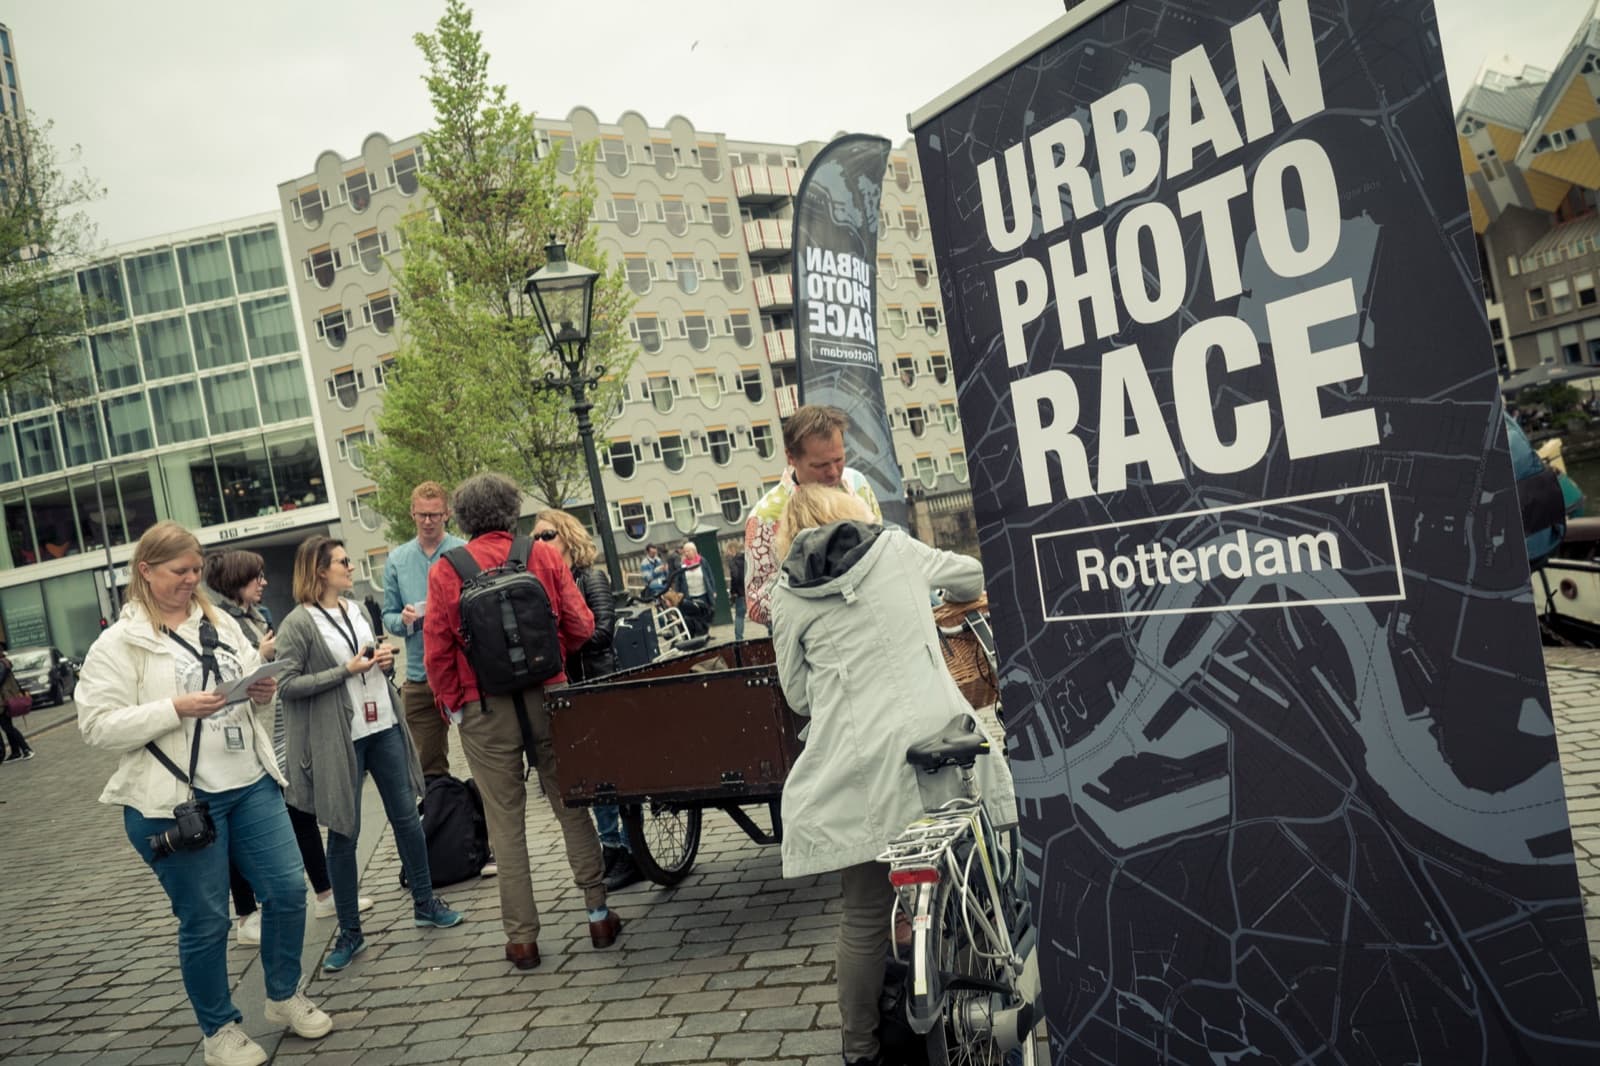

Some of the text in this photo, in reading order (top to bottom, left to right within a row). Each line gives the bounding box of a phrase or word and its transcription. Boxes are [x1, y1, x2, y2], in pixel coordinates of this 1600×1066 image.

[977, 0, 1325, 253] URBAN
[994, 138, 1340, 367] PHOTO
[1010, 279, 1380, 506] RACE
[1077, 527, 1342, 592] Rotterdam
